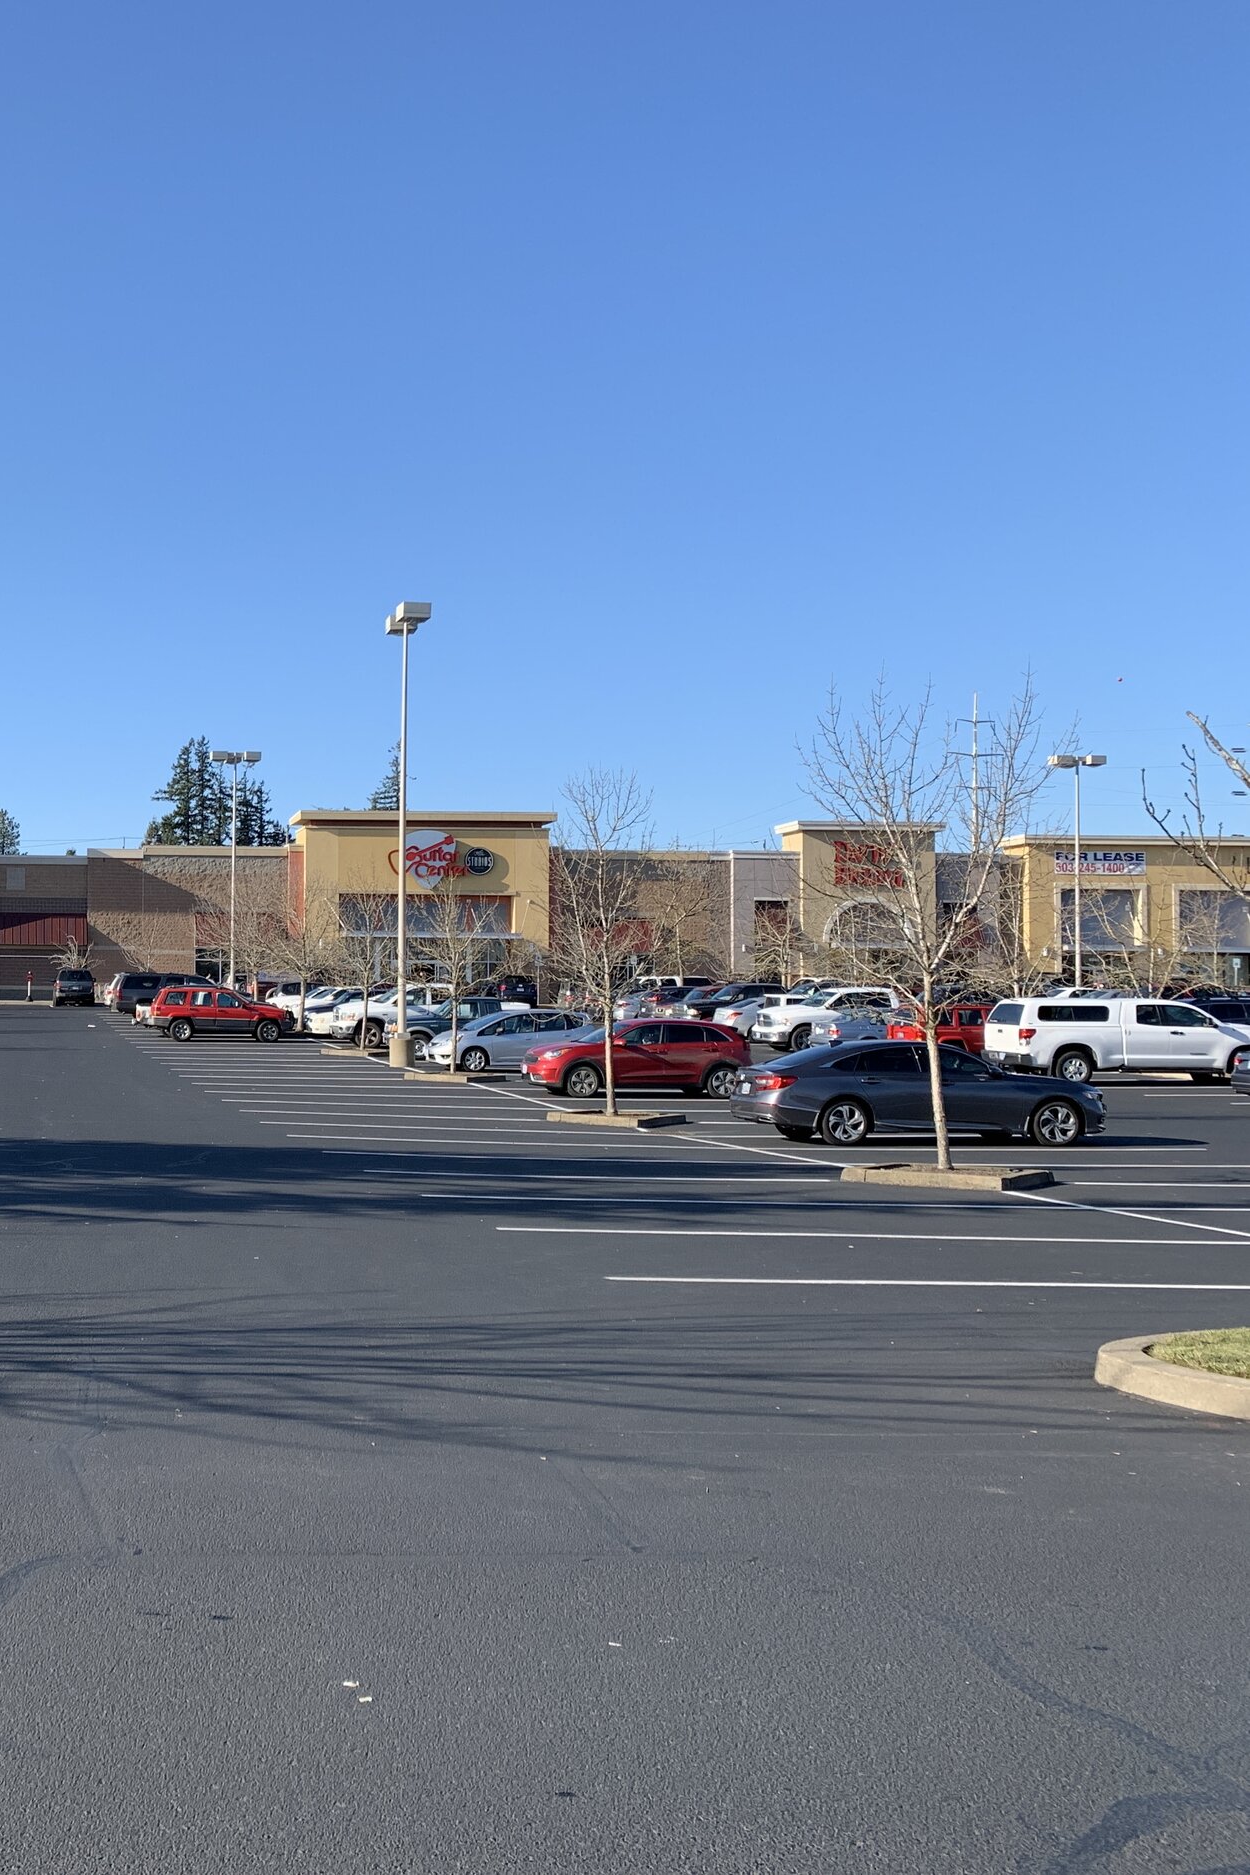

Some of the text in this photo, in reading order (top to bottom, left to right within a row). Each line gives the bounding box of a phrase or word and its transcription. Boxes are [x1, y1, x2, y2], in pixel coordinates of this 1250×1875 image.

[1055, 852, 1145, 862] FOR LEASE
[415, 862, 467, 878] Center
